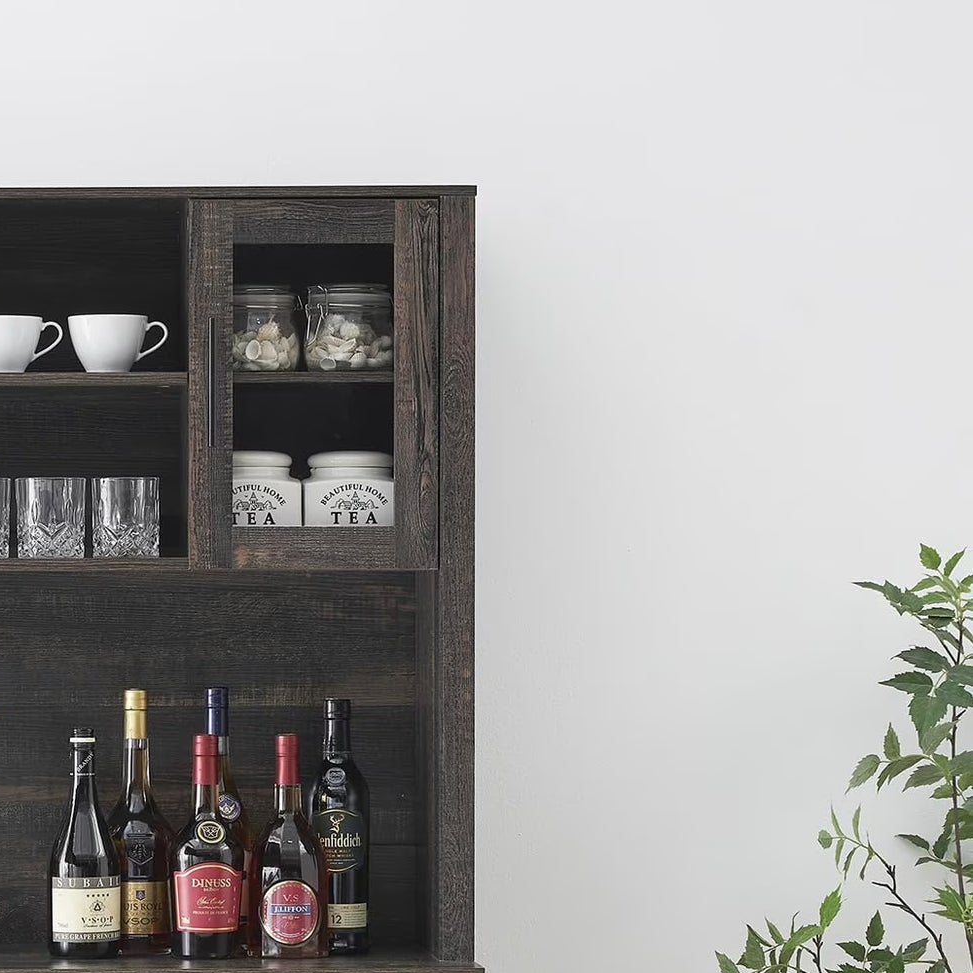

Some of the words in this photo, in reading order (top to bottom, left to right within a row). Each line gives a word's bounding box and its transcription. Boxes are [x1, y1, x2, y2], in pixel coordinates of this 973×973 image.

[232, 484, 262, 496] UTIFUL
[264, 486, 287, 506] HOME
[320, 483, 364, 506] BEAUTIFUL
[365, 485, 389, 506] HOME
[232, 512, 276, 525] TEA
[330, 511, 378, 525] TEA
[317, 832, 361, 848] enfiddich
[331, 914, 342, 924] 12
[54, 932, 70, 940] PURE
[69, 932, 92, 941] GRAPE
